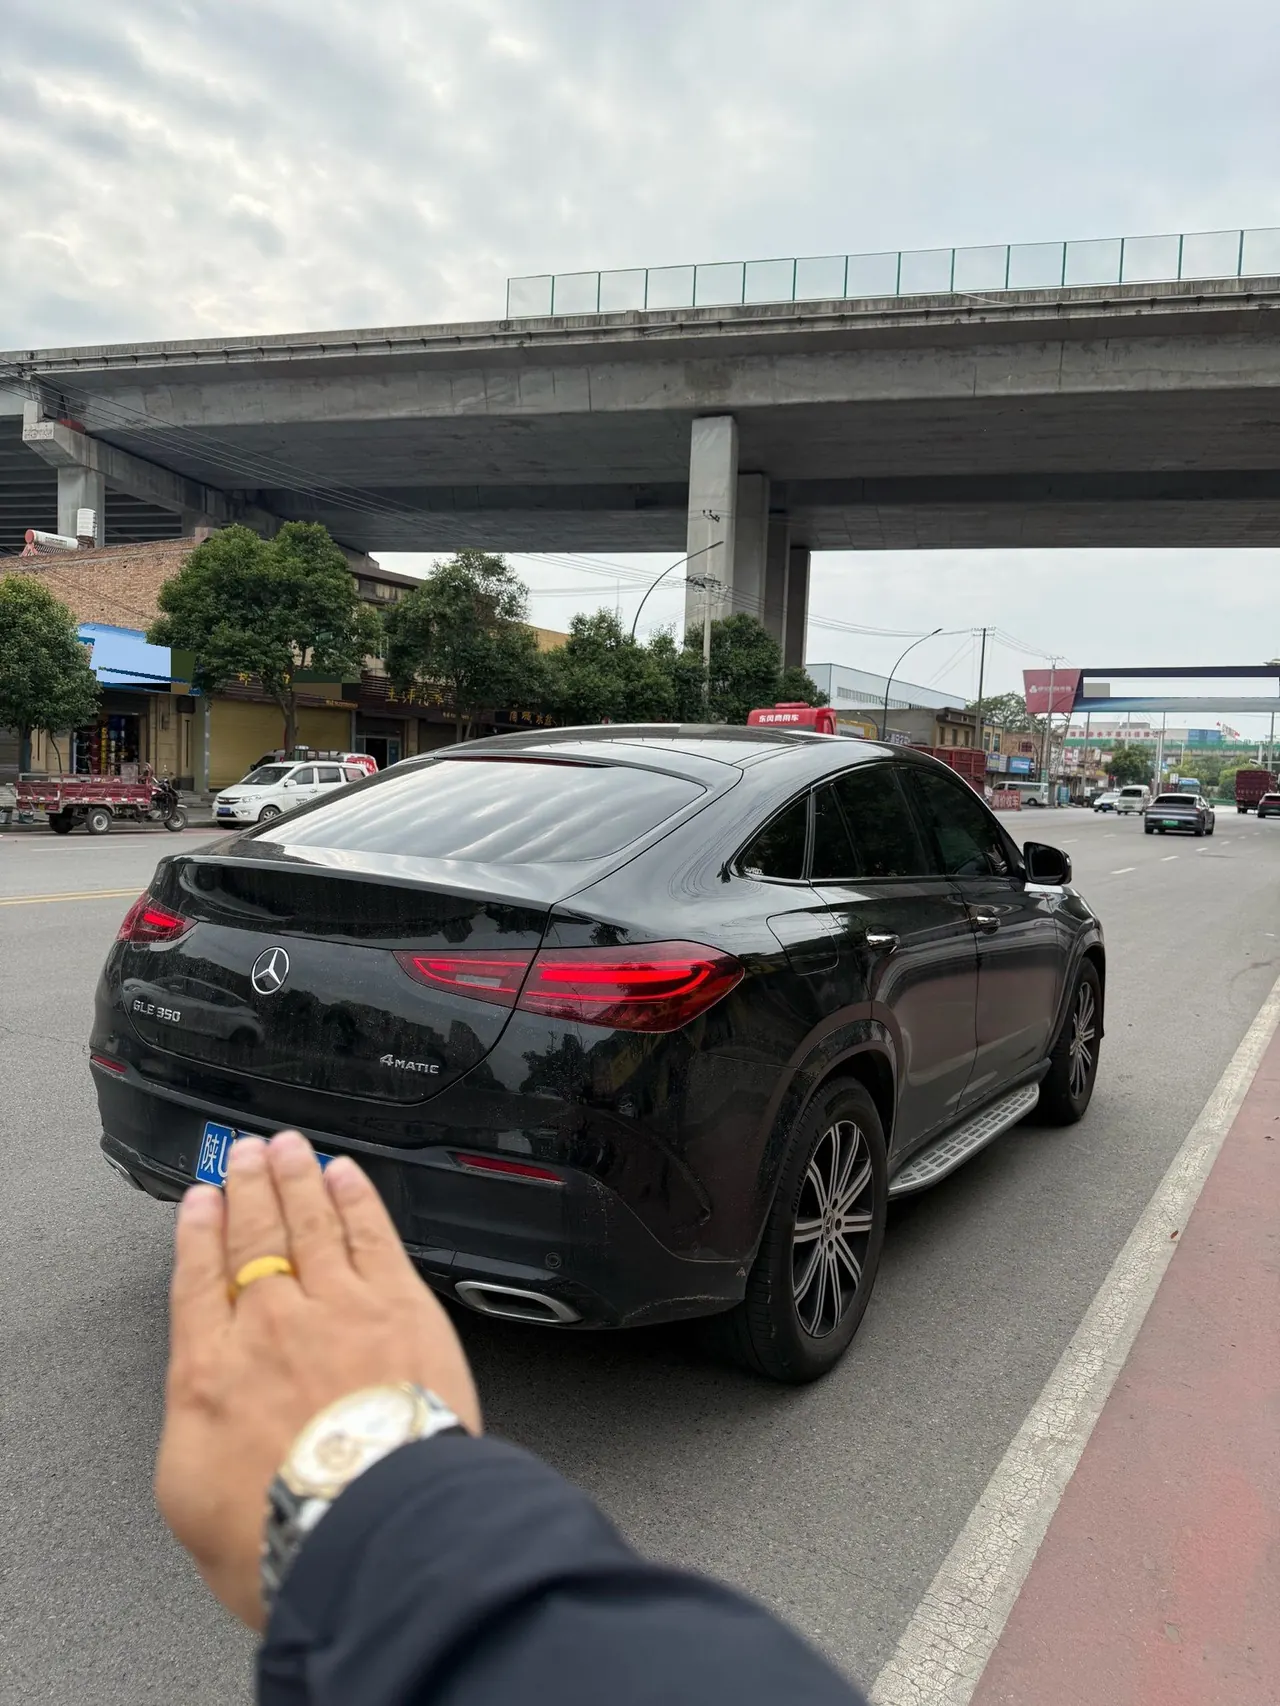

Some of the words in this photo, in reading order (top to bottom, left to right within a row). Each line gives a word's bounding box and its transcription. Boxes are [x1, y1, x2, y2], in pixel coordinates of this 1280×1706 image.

[759, 714, 799, 722] 东风商用车
[133, 1000, 155, 1015] GLE
[156, 1007, 181, 1022] 350
[380, 1054, 440, 1074] 4MATIC
